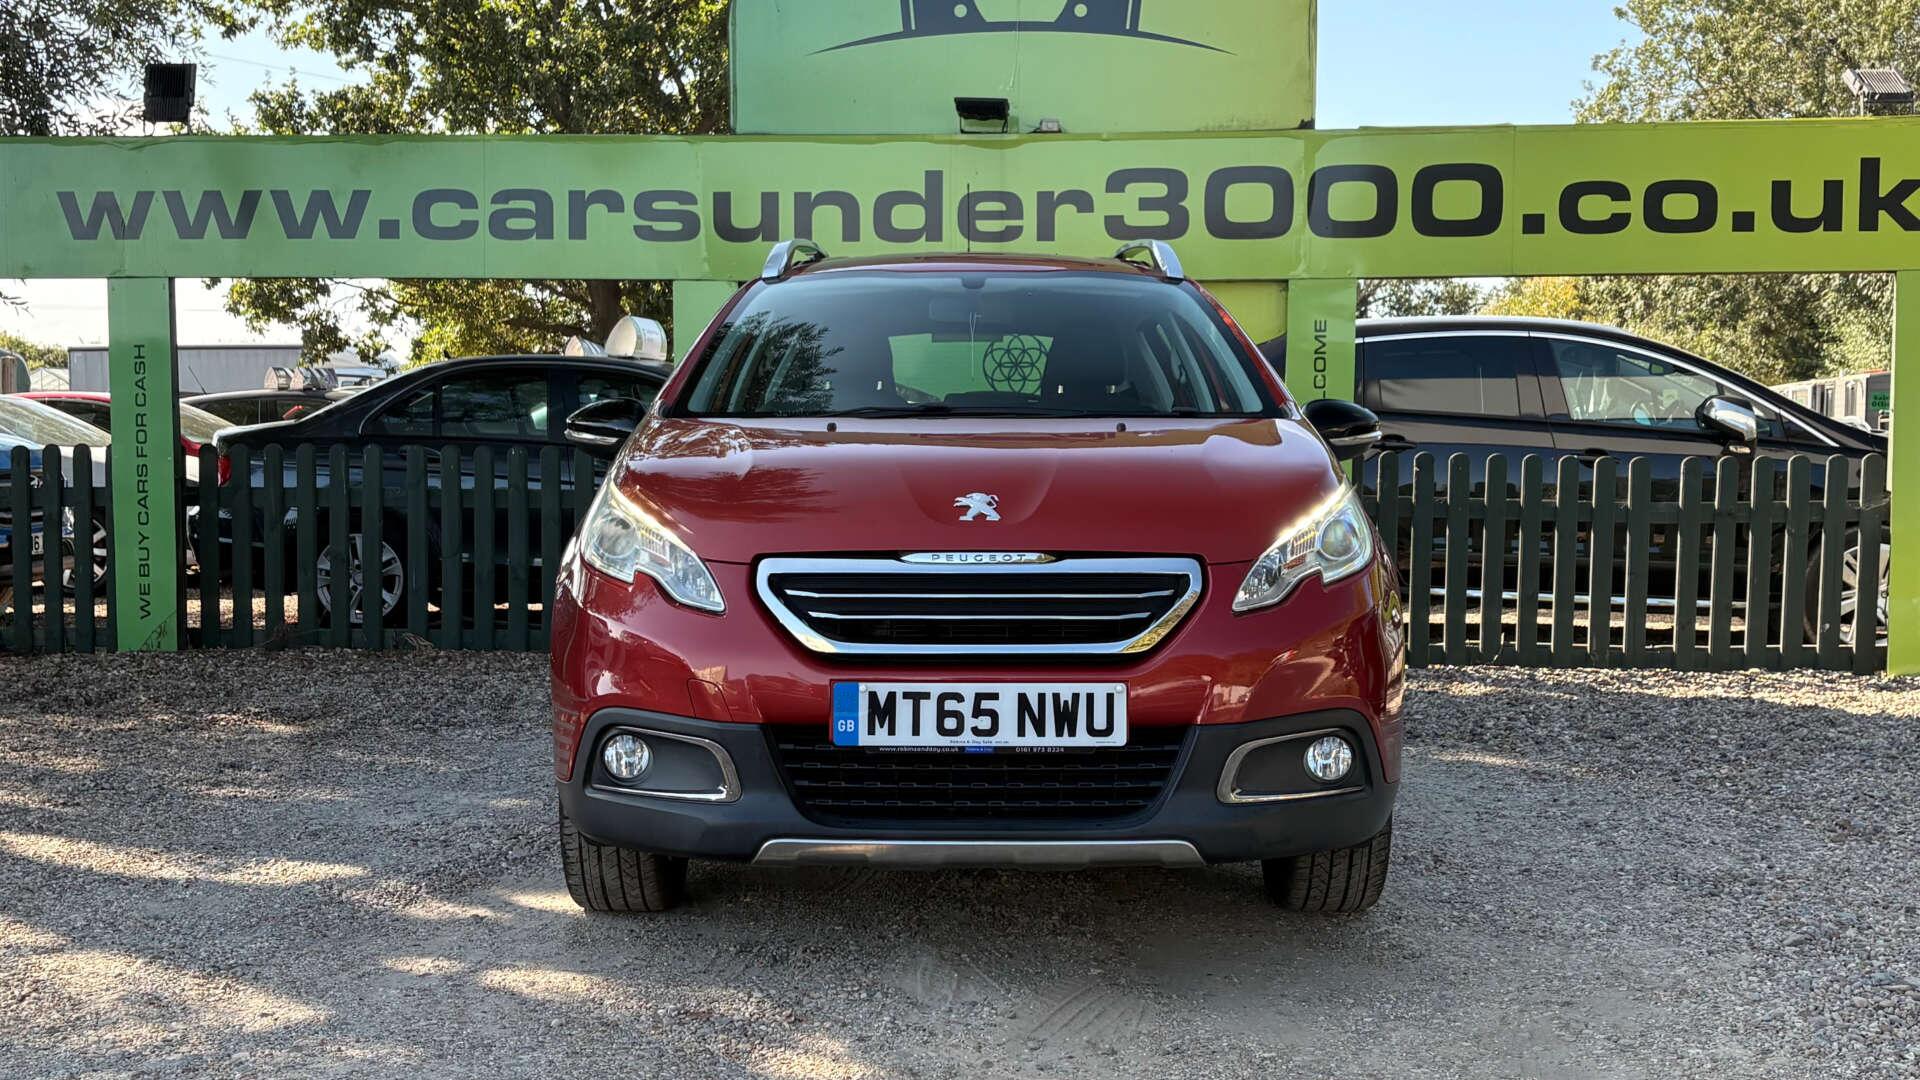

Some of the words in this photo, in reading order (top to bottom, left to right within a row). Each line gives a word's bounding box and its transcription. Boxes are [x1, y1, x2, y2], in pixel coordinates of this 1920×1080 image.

[57, 156, 1920, 243] www.carsunder3000.co.uk
[133, 344, 147, 408] CASH
[135, 412, 148, 459] FOR
[136, 463, 149, 526] CARS
[138, 531, 150, 578] BUY
[931, 554, 1026, 562] PEUGEOT
[139, 582, 151, 620] WE
[837, 719, 855, 732] GB
[867, 690, 1000, 738] MT65
[1016, 691, 1115, 738] NWU
